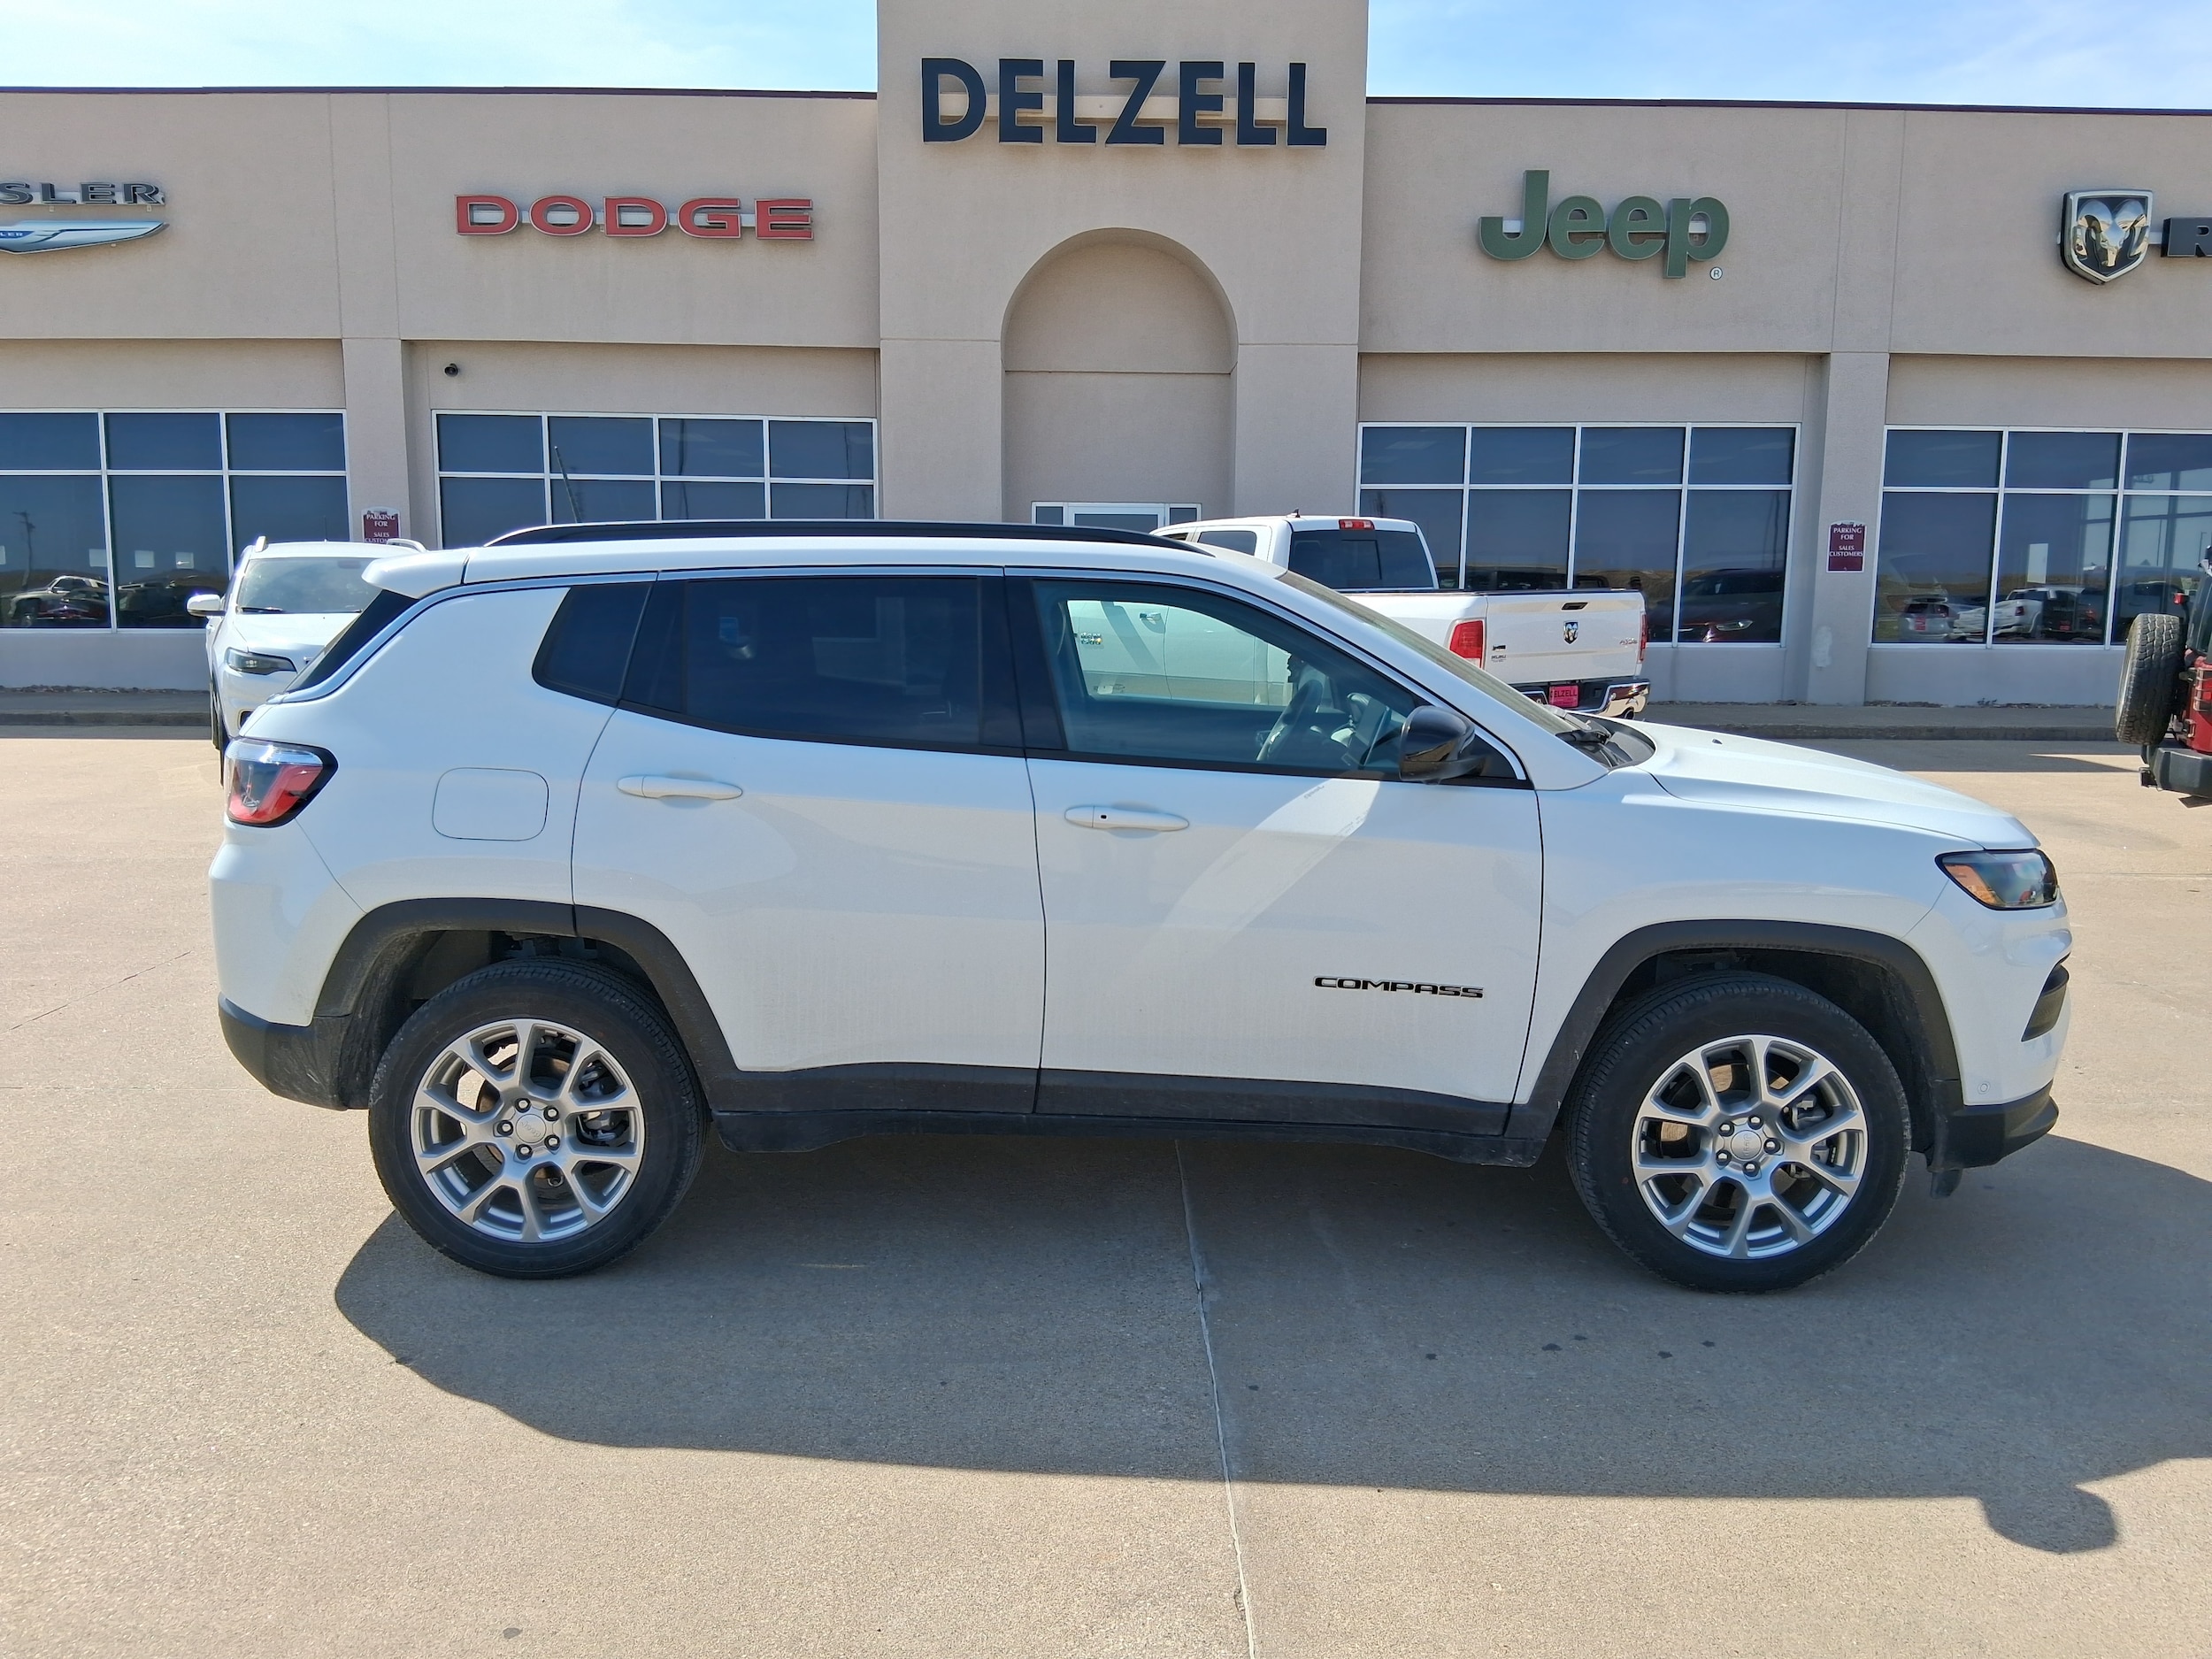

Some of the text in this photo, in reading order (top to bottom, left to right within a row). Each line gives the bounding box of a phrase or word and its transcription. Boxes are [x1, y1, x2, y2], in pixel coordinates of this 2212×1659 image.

[921, 58, 1327, 148] DELZELL
[455, 195, 814, 241] DODGE
[1479, 169, 1730, 278] Jeep
[1314, 977, 1484, 999] COMPASS
